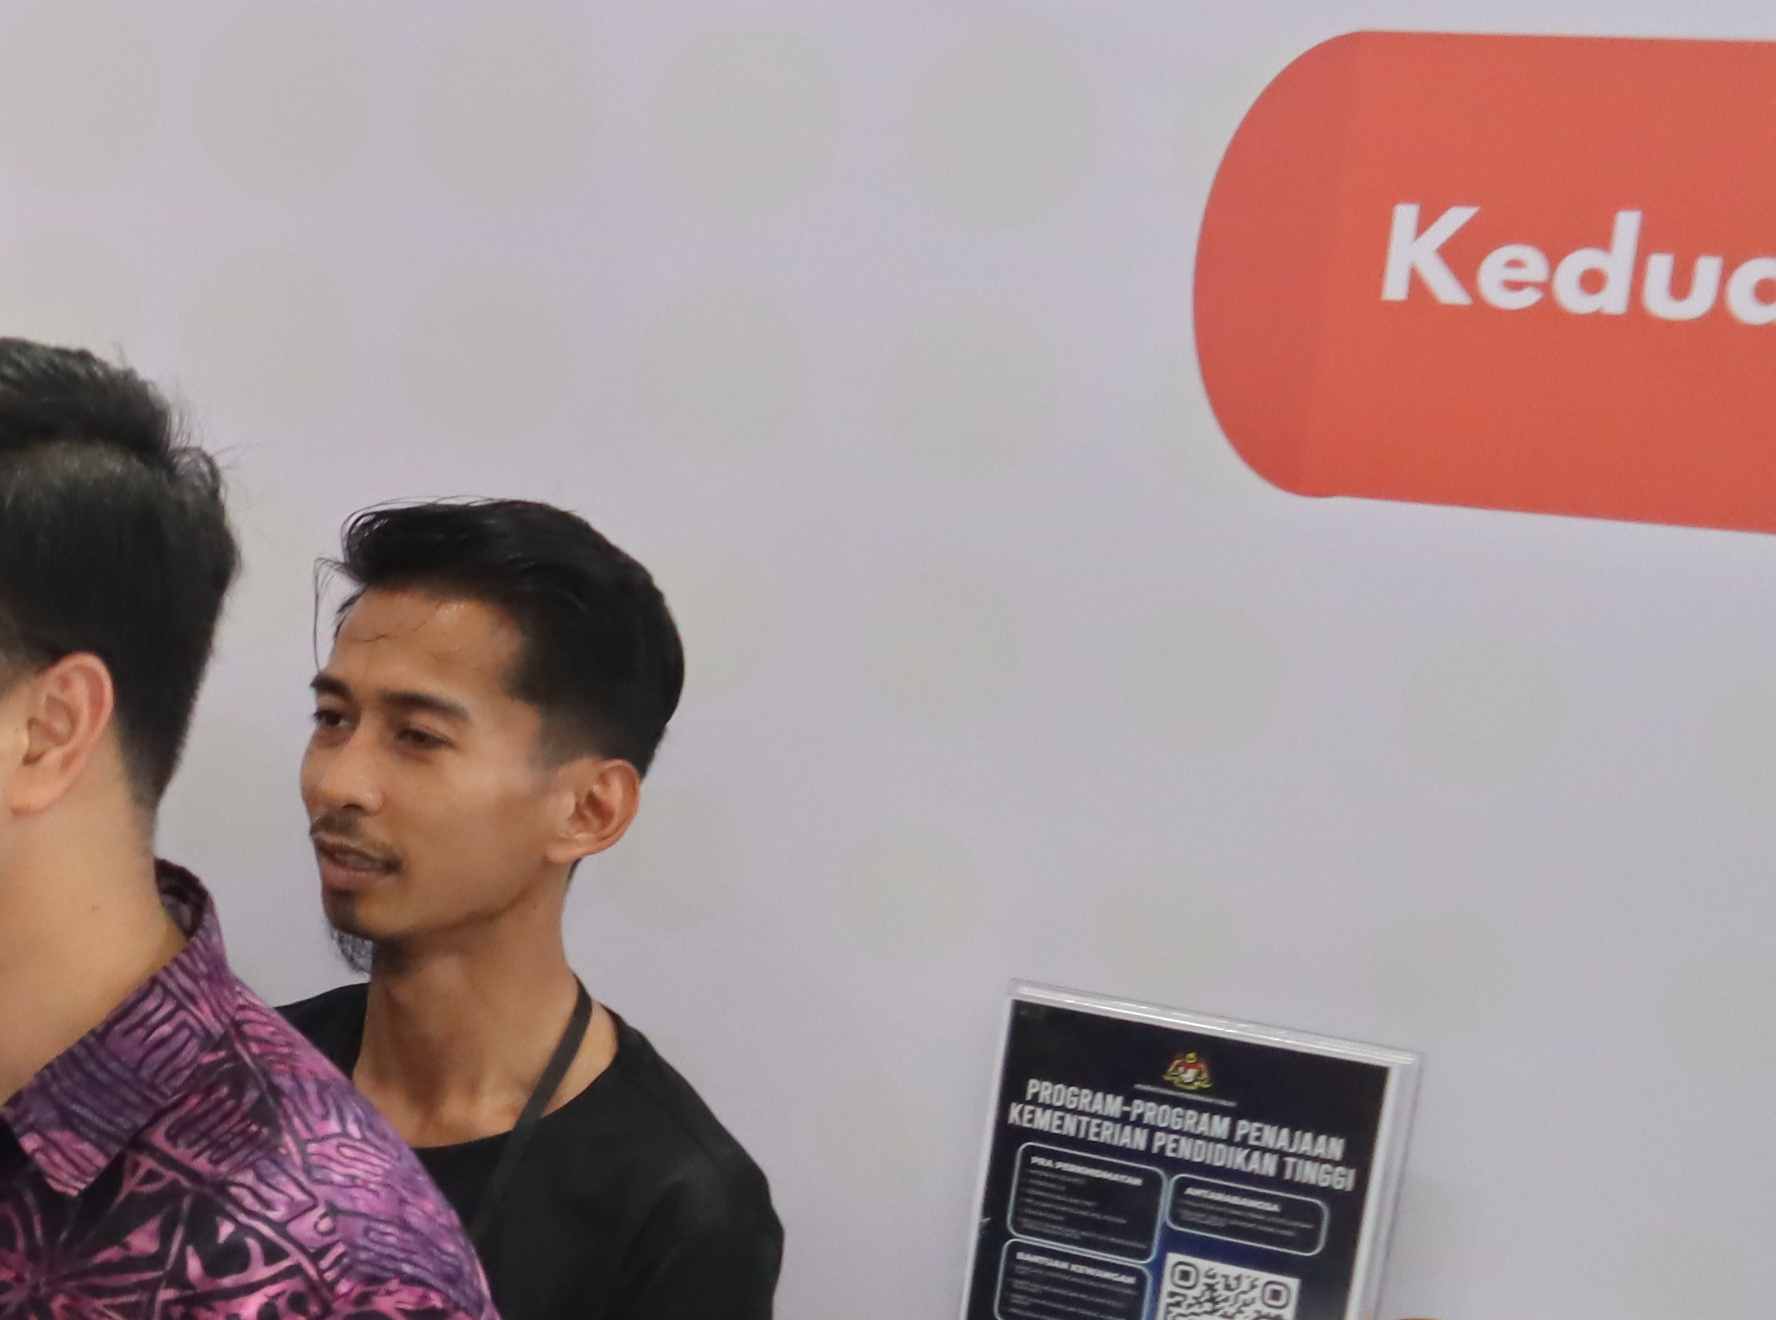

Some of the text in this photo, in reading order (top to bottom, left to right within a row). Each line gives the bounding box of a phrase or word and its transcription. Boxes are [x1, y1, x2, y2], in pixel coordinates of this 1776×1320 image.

[1008, 1102, 1357, 1192] KEMENTERIAN PENDIDIKAN TINGGI
[1025, 1078, 1232, 1142] PROGRAM-PROGRAM
[1234, 1119, 1345, 1161] PENAJAAN
